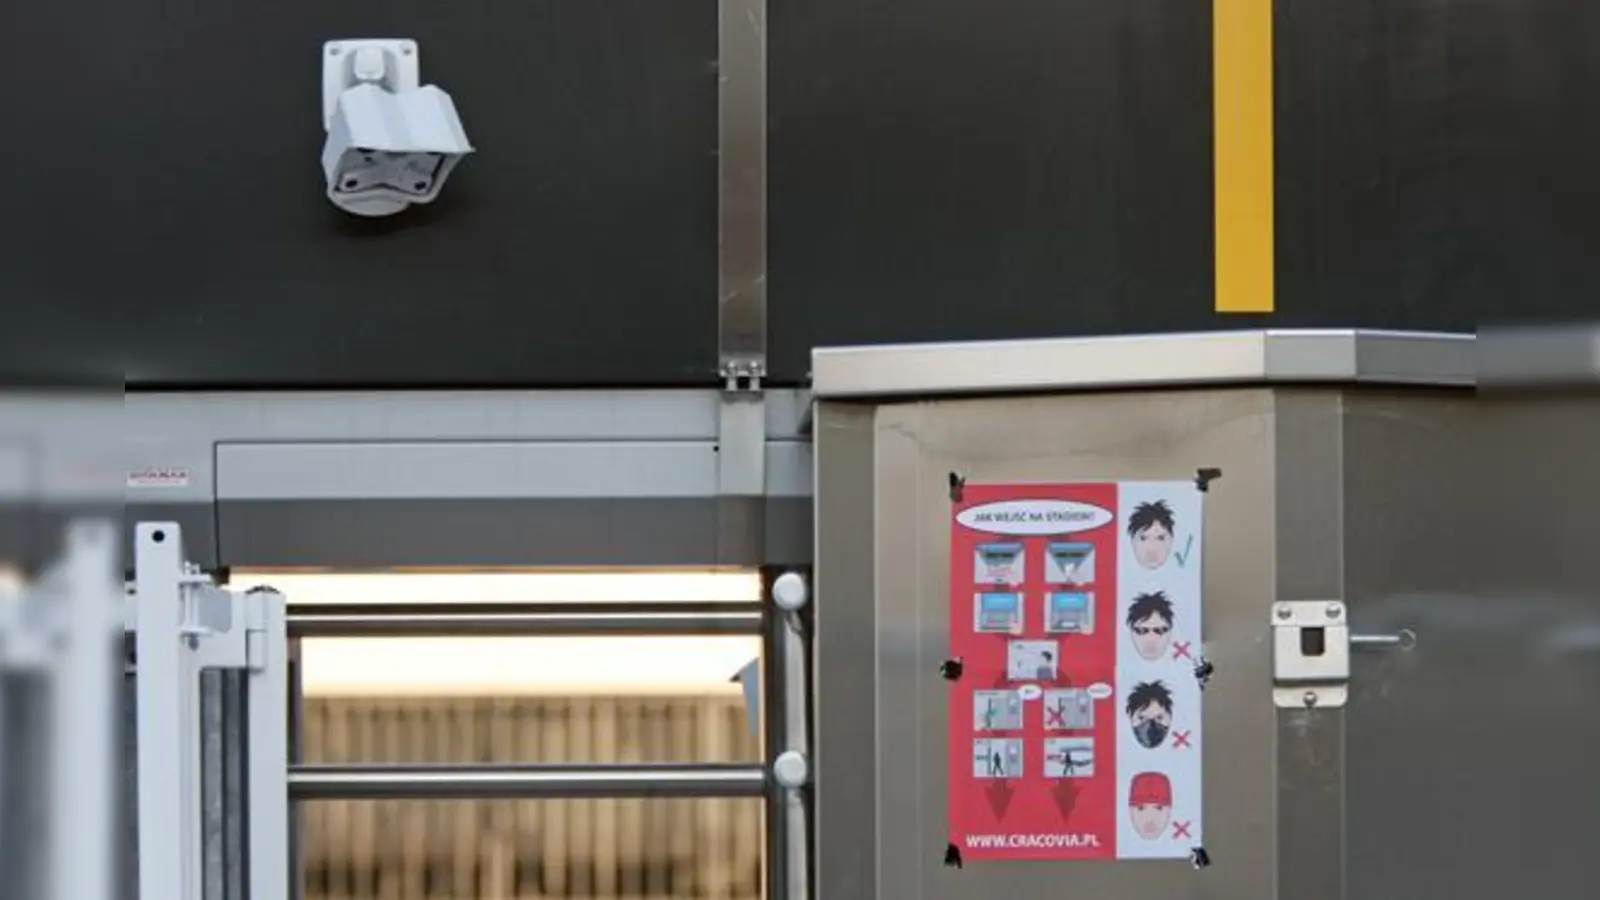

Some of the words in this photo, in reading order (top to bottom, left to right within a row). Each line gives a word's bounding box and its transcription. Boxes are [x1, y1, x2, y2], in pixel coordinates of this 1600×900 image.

[974, 511, 991, 522] JAK
[1028, 511, 1043, 522] NA
[965, 833, 1101, 848] WWW.CRACOVIA.PL
